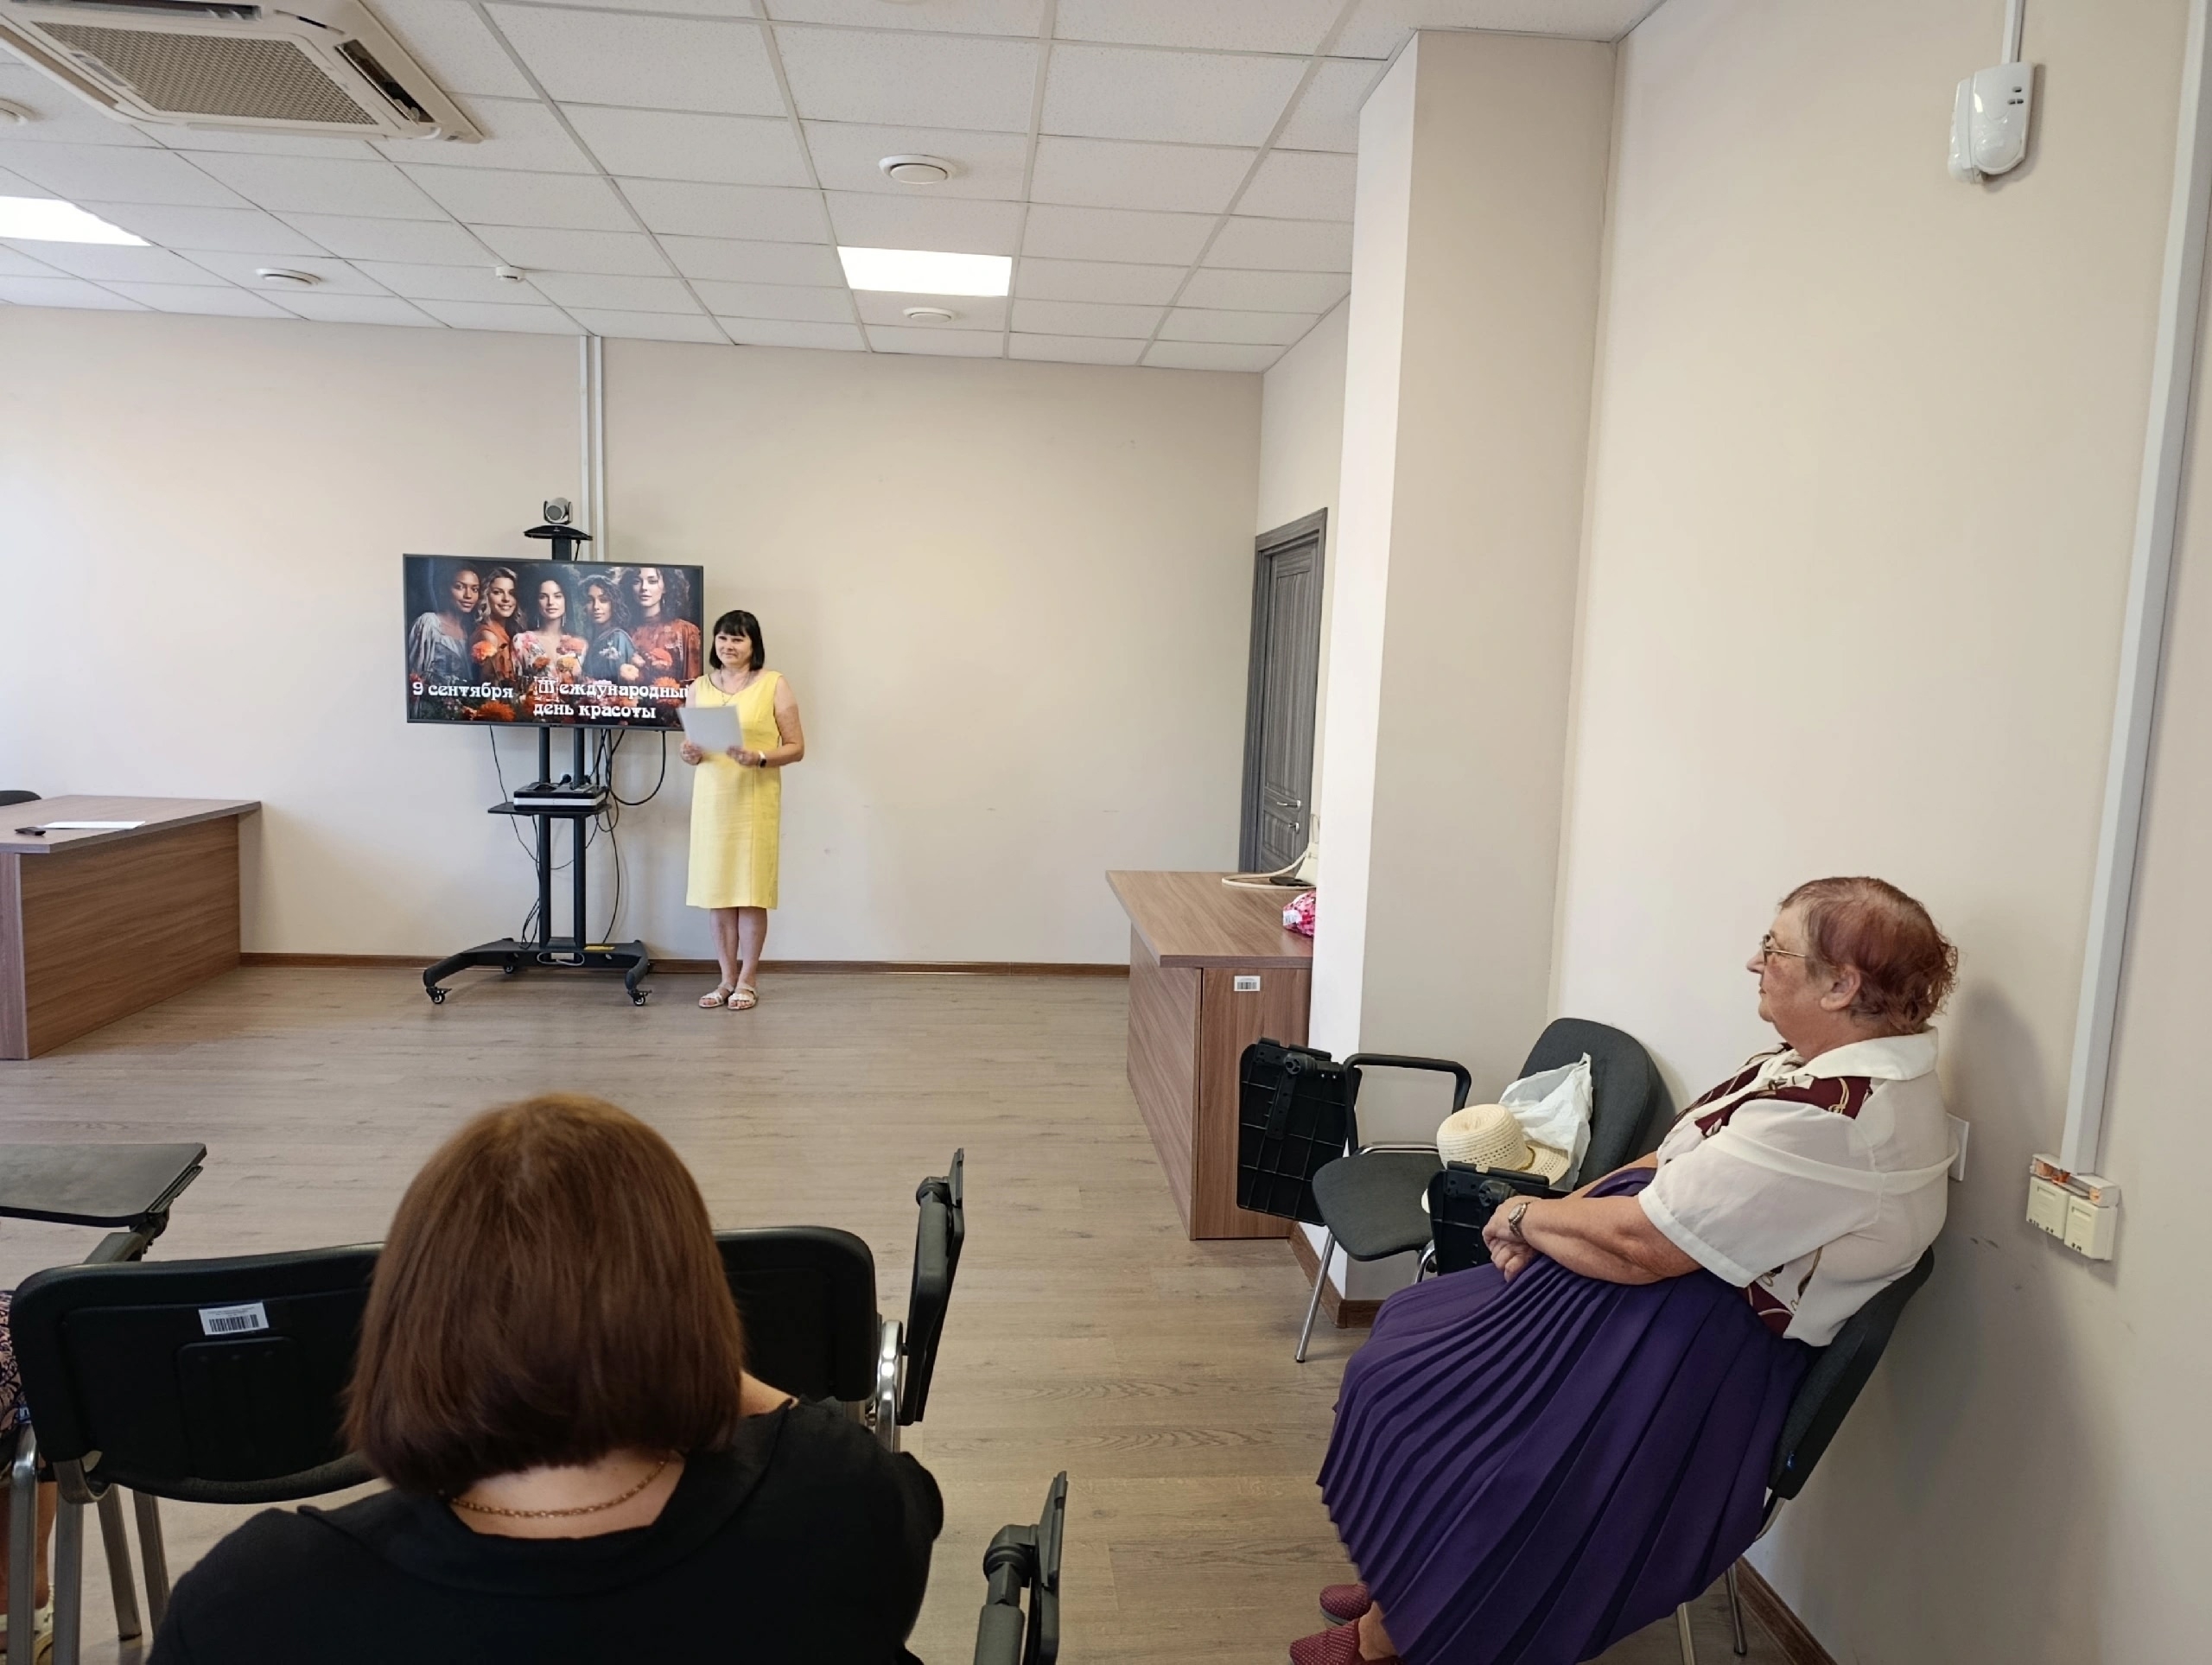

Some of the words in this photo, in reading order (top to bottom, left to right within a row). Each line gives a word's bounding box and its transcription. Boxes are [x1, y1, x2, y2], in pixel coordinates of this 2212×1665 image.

[413, 682, 423, 696] 9
[428, 683, 513, 700] сентября
[533, 703, 574, 715] день
[579, 704, 656, 719] красоты
